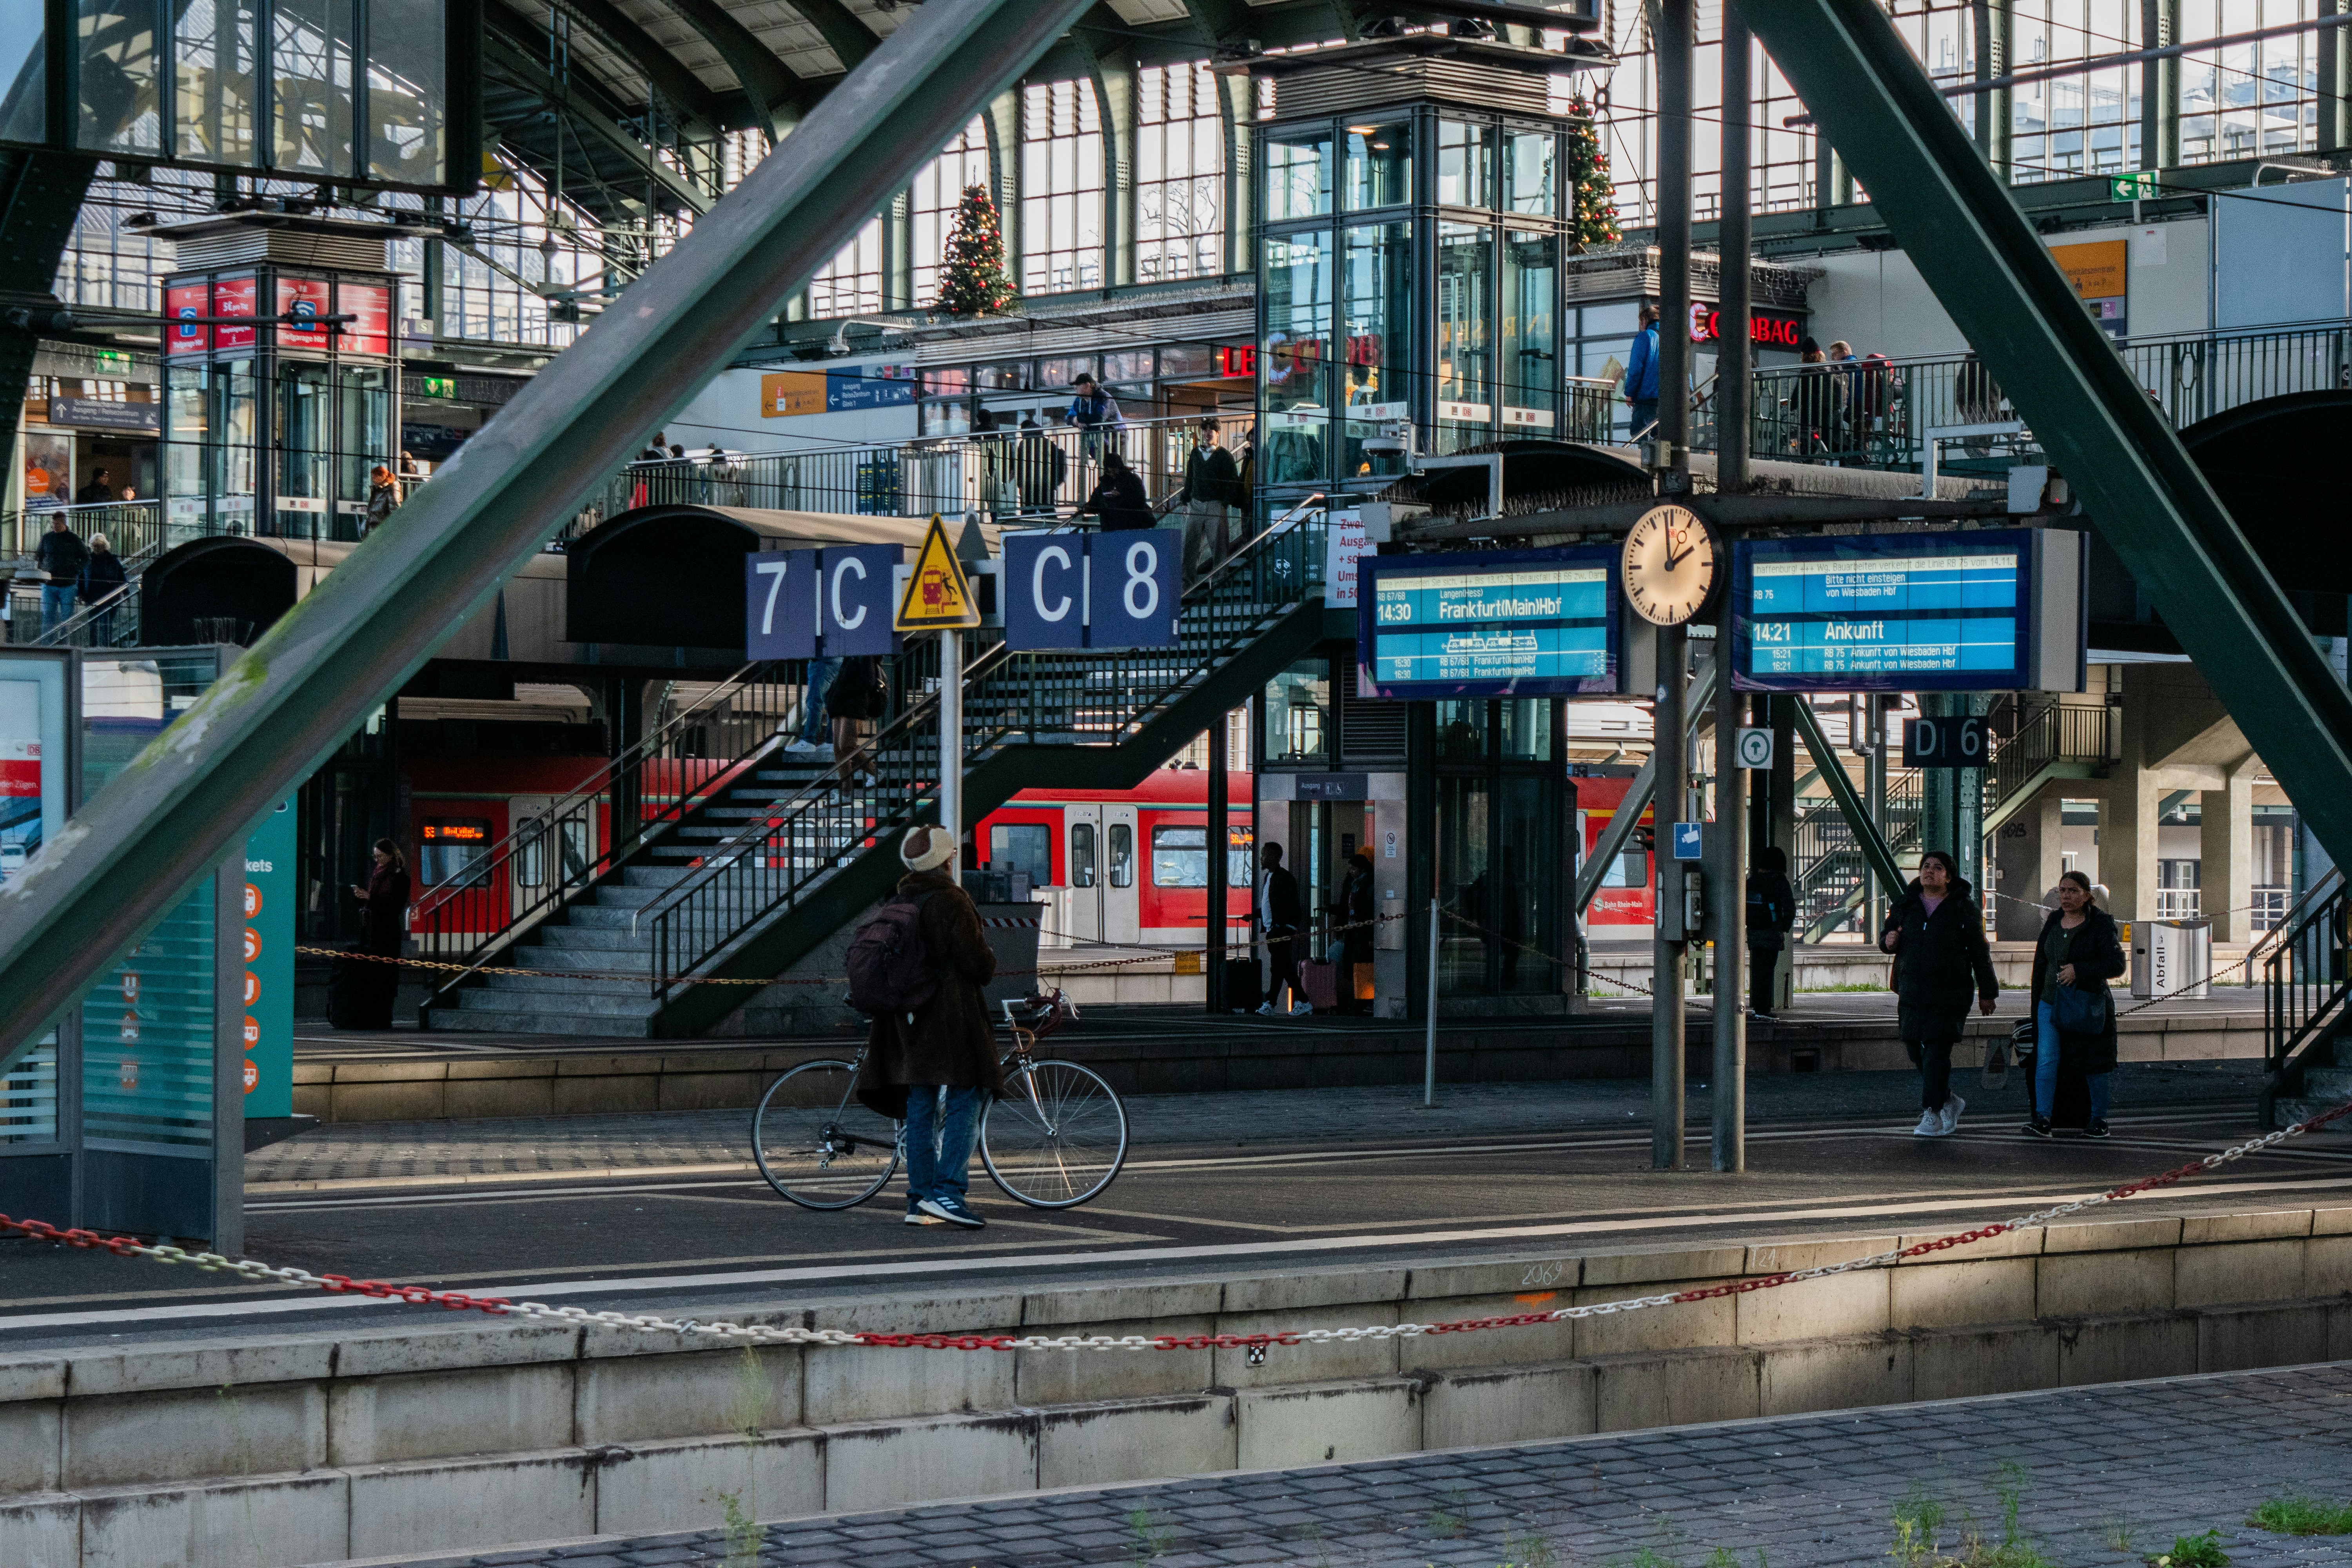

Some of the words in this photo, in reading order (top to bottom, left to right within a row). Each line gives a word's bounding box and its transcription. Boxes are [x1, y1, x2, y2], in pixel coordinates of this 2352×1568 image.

[400, 320, 409, 338] 4
[421, 323, 427, 332] S
[1710, 312, 1798, 345] CBAG
[73, 407, 97, 415] Ausgang
[1757, 564, 1797, 574] haffenburg!
[1817, 563, 1830, 573] Wg.
[1833, 561, 1876, 572] Bauarbeiten
[1915, 560, 1926, 568] die
[1928, 559, 1944, 568] Linie
[1947, 559, 1956, 568] RB
[1991, 557, 2013, 566] 14.11.
[1033, 546, 1072, 621] C
[1124, 541, 1158, 619] 8
[1394, 579, 1430, 588] informieren
[1443, 577, 1457, 586] sich.
[1475, 576, 1484, 584] Bis
[1487, 575, 1512, 584] 13.12.25
[1516, 573, 1551, 583] Teilausfall
[1553, 572, 1562, 581] RB
[1564, 572, 1572, 580] 66
[1589, 571, 1606, 579] Darm
[1826, 574, 1844, 584] Bitte
[1846, 574, 1865, 583] nicht
[1867, 573, 1906, 583] einsteigen
[757, 562, 786, 634] 7
[831, 557, 867, 630] C
[1337, 588, 1346, 599] in
[1377, 592, 1385, 601] RB
[1387, 592, 1406, 601] 67/68
[1440, 588, 1483, 599] Langen(Hess)
[1753, 589, 1763, 599] RB
[1765, 589, 1774, 599] 75
[1826, 589, 1839, 597] von
[1842, 586, 1881, 597] Wiesbaden
[1883, 586, 1896, 595] Hbf
[1378, 603, 1411, 621] 14:30
[1439, 596, 1562, 619] Frankfurt(Main)Hbf
[1753, 623, 1790, 641] 14:21
[1824, 621, 1884, 640] Ankunft
[1772, 649, 1791, 659] 15:21
[1824, 648, 1834, 657] RB
[1836, 648, 1845, 657] 75
[1851, 648, 1881, 657] Ankunft
[1900, 647, 1940, 656] Wiesbaden
[1942, 646, 1956, 655] Hbf
[1394, 659, 1411, 668] 15:30
[1440, 657, 1448, 666] RB
[1450, 657, 1469, 666] 67/68
[1474, 655, 1536, 665] Frankfurt(Main)Hbf
[1772, 661, 1791, 671] 16:21
[1824, 661, 1833, 670] RB
[1836, 661, 1844, 670] 75
[1851, 660, 1881, 669] Ankunft
[1900, 659, 1940, 669] Wiesbaden
[1942, 658, 1955, 668] Hbf
[1394, 670, 1411, 679] 16:30
[1440, 669, 1448, 678] RB
[1450, 668, 1469, 677] 67/68
[1474, 666, 1536, 677] Frankfurt(Main)Hbf
[1916, 720, 1936, 755] D
[1961, 719, 1980, 755] 6
[2156, 947, 2165, 988] Abfall
[1522, 1261, 1563, 1285] 2069
